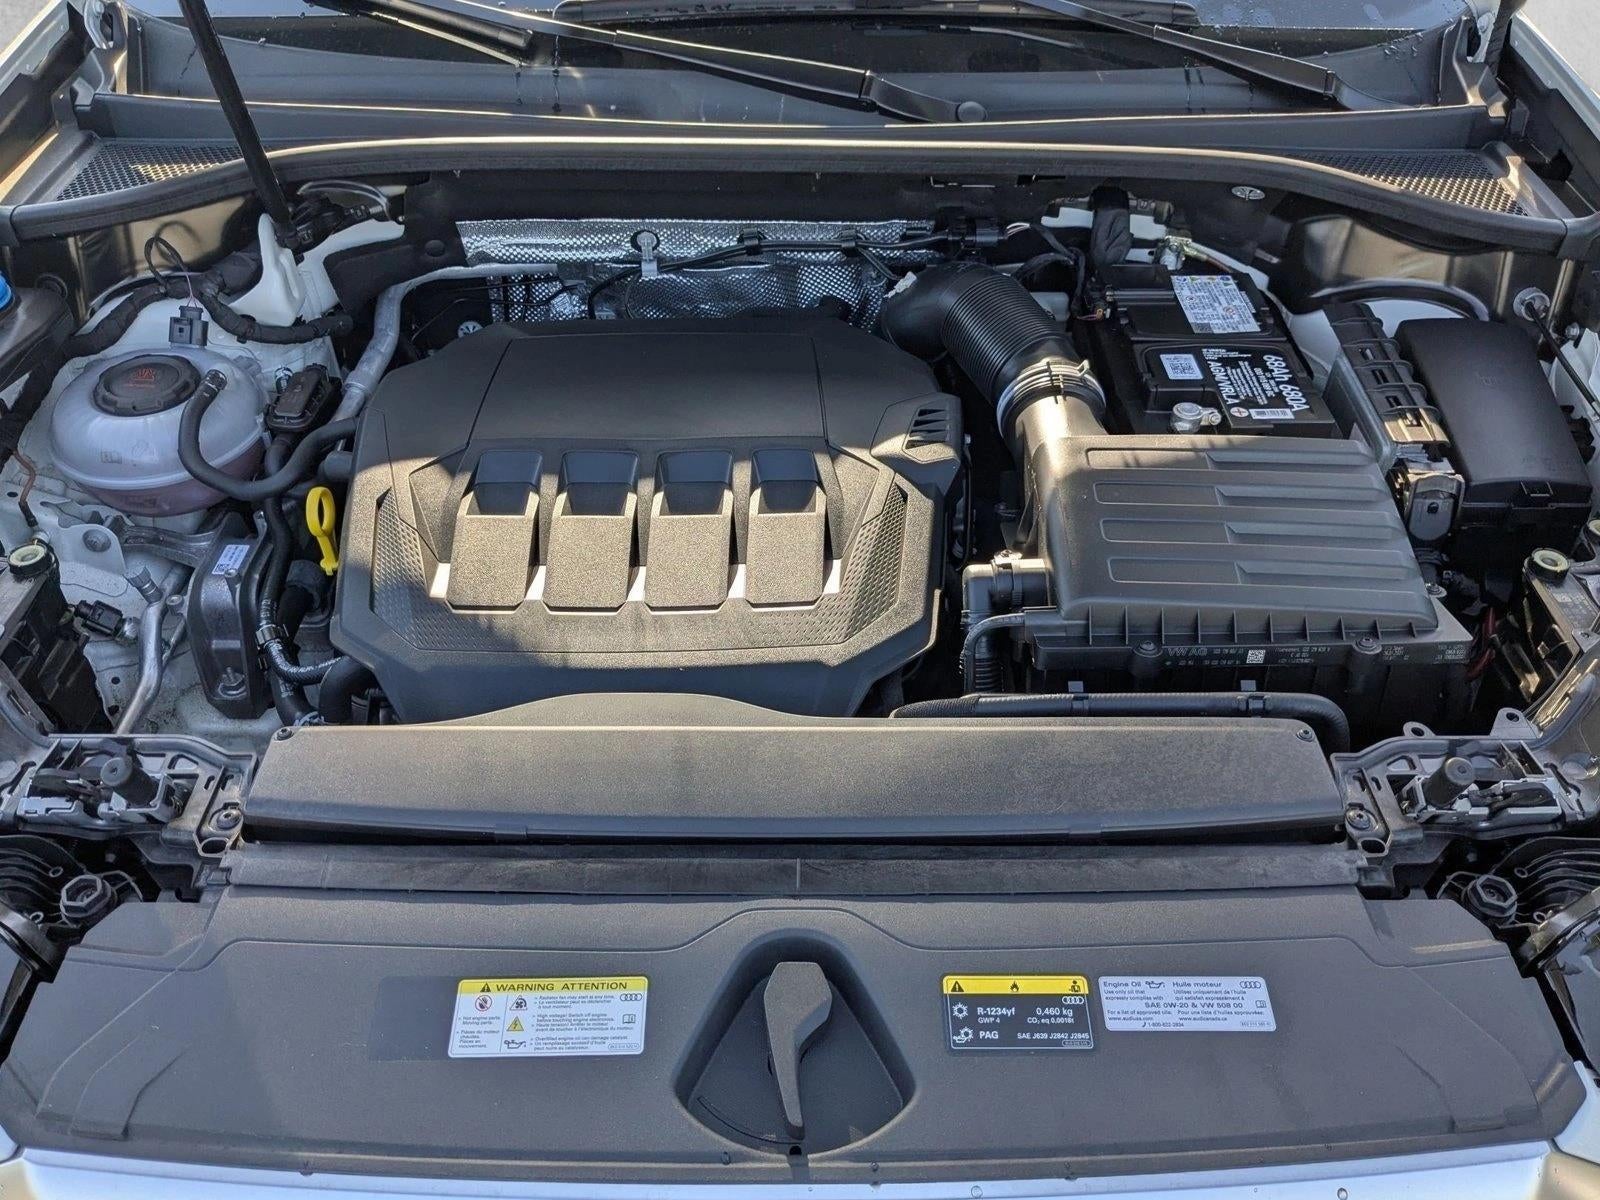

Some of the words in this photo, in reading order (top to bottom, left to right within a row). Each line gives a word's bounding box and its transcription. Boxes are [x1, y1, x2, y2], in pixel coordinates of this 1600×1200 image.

[1263, 355, 1292, 381] 68Ah
[1279, 384, 1310, 411] 680A
[496, 983, 555, 992] WARNING
[561, 982, 628, 991] ATTENTION
[977, 1007, 1016, 1017] R-1234yf
[1036, 1007, 1060, 1016] 0,460
[1062, 1007, 1073, 1017] kg
[979, 1031, 999, 1039] PAG
